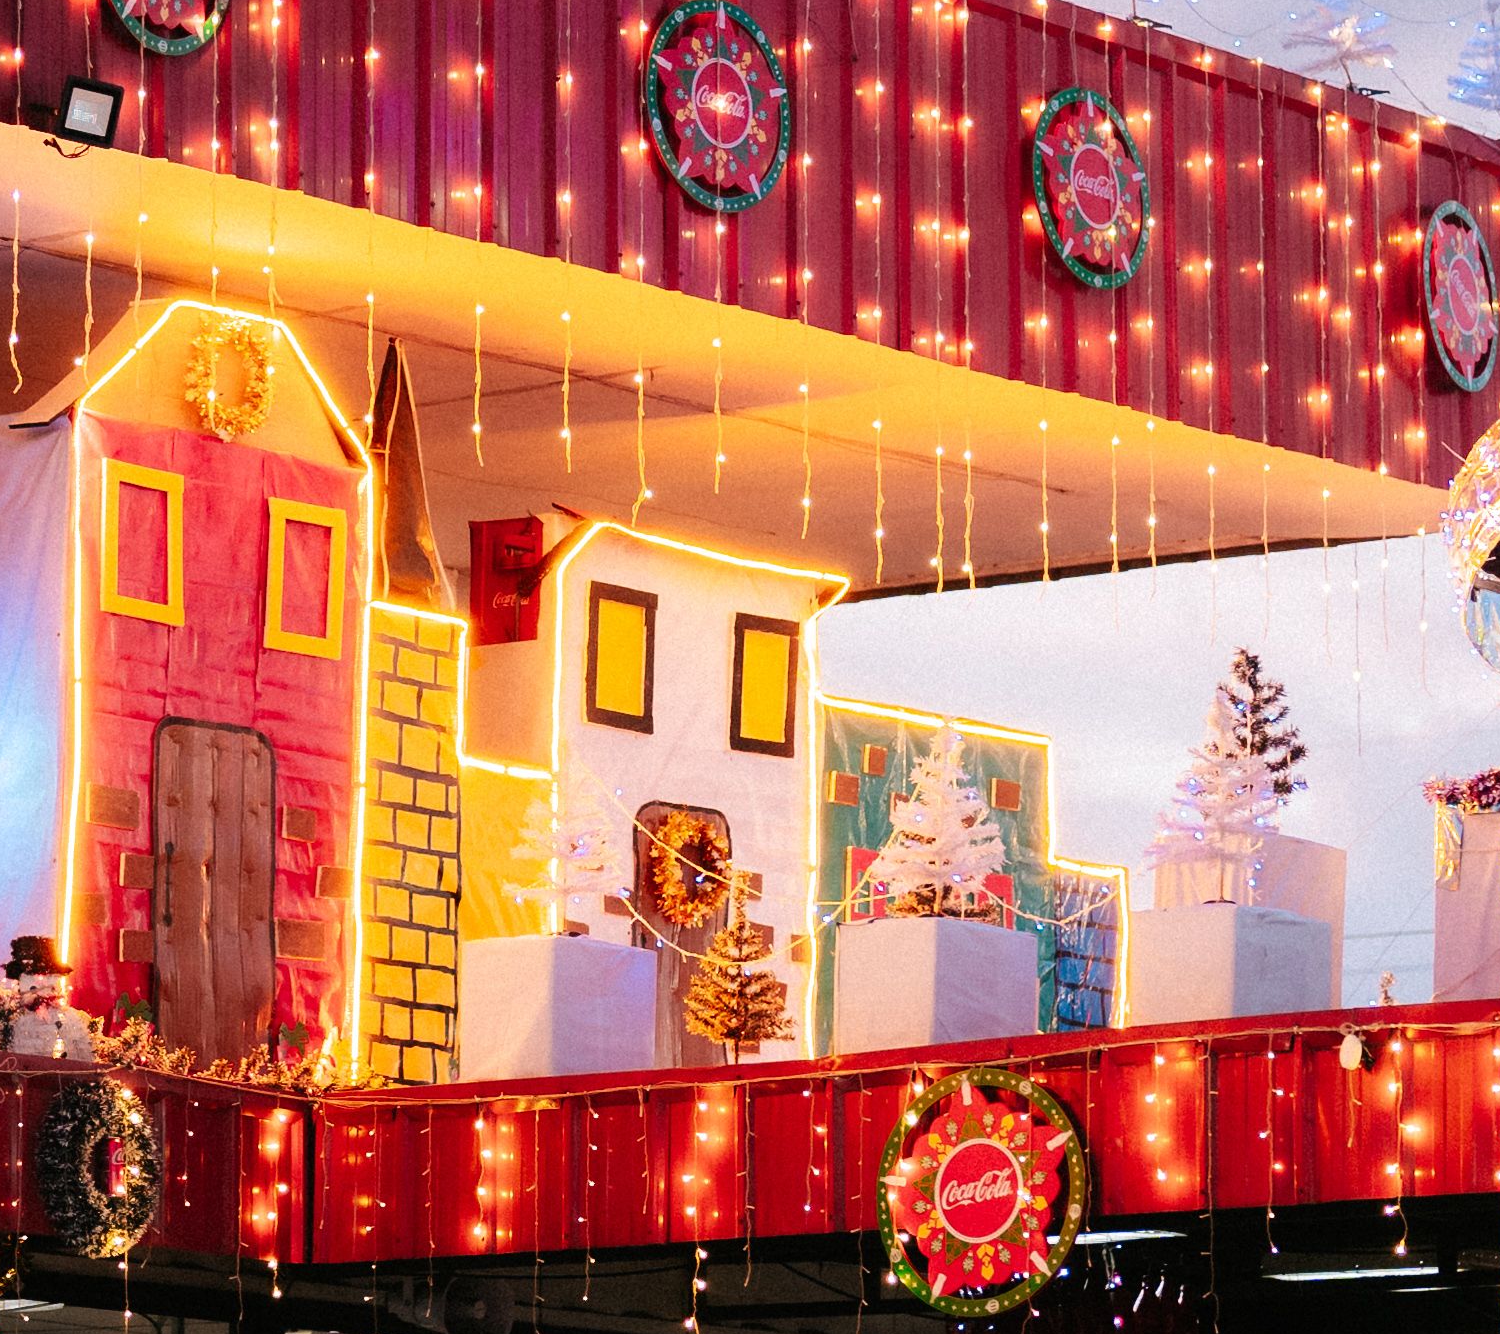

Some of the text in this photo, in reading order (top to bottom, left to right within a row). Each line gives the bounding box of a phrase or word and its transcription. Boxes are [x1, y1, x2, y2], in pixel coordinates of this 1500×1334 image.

[1074, 169, 1115, 202] Coca-Cola
[492, 591, 531, 609] Coca-Cla
[941, 1167, 1014, 1210] Coca-Cola
